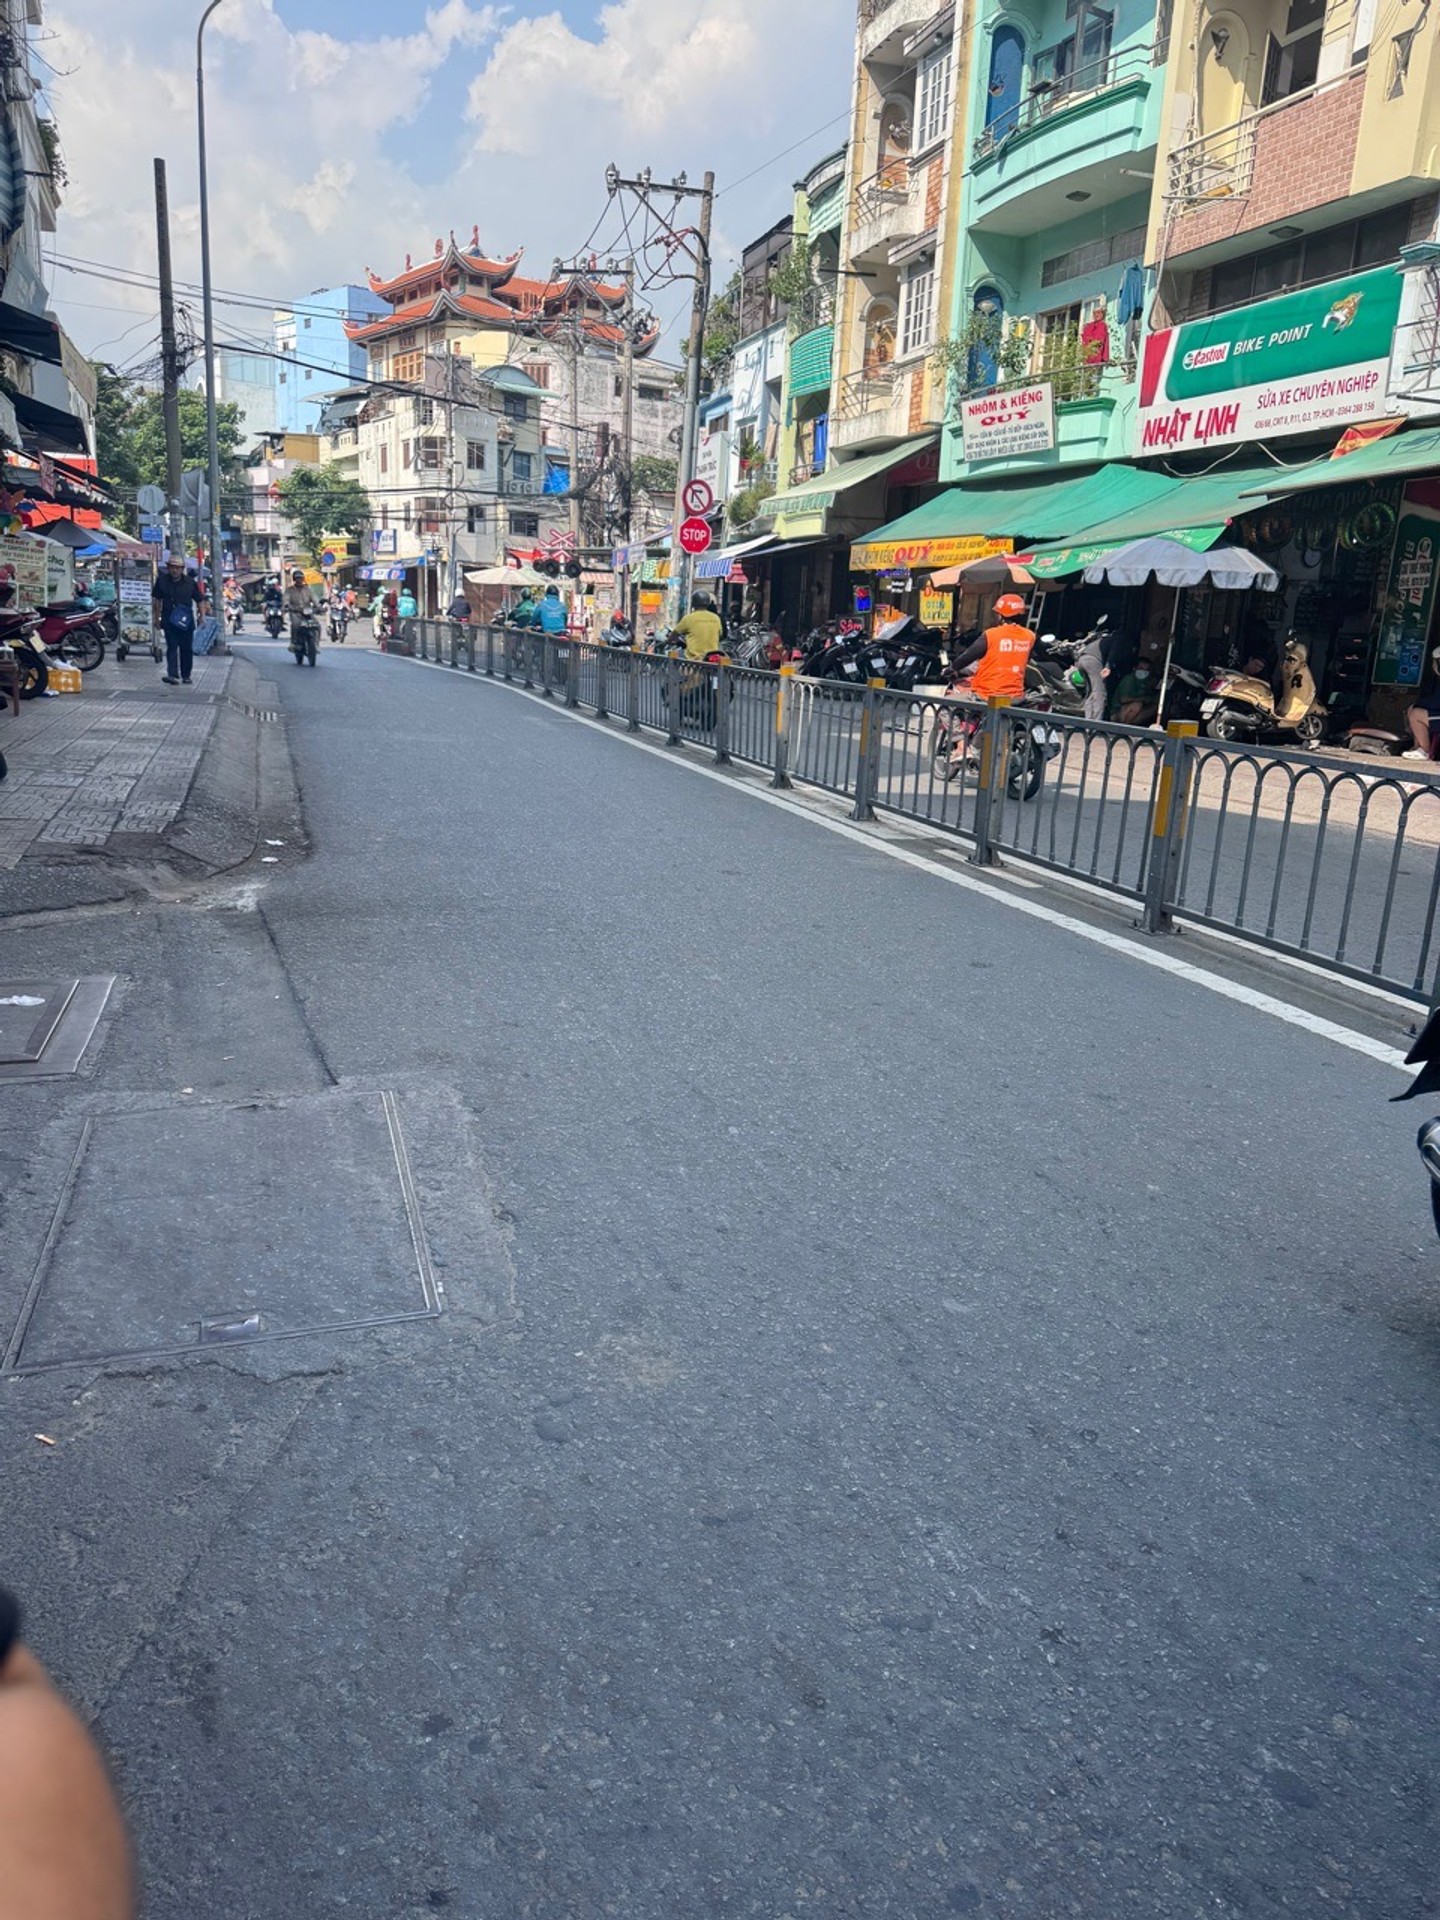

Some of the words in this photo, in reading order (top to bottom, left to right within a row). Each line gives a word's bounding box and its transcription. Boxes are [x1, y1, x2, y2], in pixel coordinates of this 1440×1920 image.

[1193, 345, 1227, 367] Castrol
[1233, 336, 1266, 356] BIKE
[1268, 324, 1313, 347] POINT
[968, 400, 997, 417] NHÔM
[1000, 398, 1007, 410] &
[1010, 389, 1043, 408] KIẾNG
[1257, 388, 1276, 409] SỬA
[1278, 390, 1292, 405] XE
[1293, 379, 1336, 402] CHUYÊN
[1337, 370, 1379, 394] NGHIỆP
[981, 406, 1032, 427] QUÝ
[1142, 407, 1192, 449] NHẬT
[1193, 402, 1241, 444] LỊNH
[682, 528, 707, 541] STOP
[894, 541, 934, 565] QUÝ
